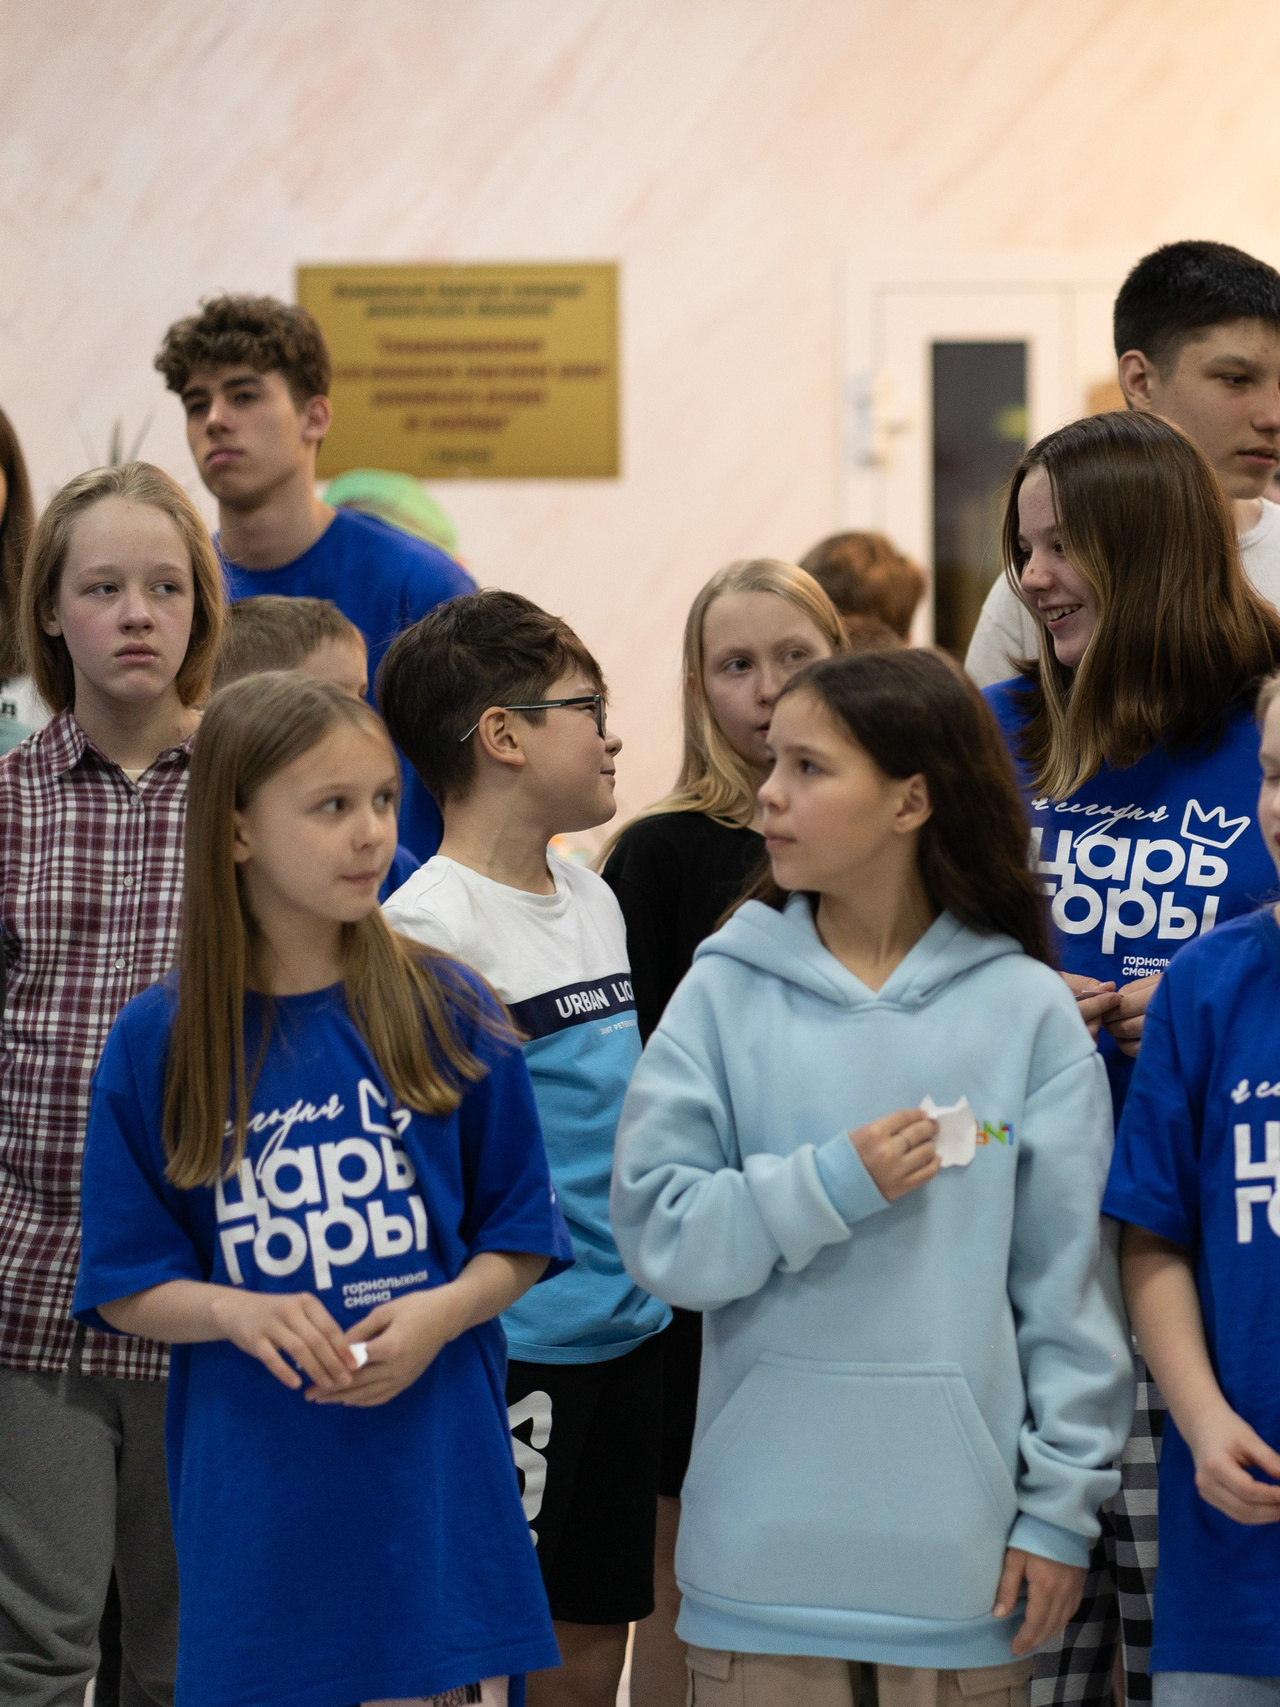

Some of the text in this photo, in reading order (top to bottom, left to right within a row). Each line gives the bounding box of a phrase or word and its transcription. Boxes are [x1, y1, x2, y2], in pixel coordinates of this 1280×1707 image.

[1055, 801, 1170, 848] сегодня
[1028, 827, 1229, 889] царь
[555, 988, 610, 1019] URBAN
[1230, 1078, 1251, 1105] я
[214, 1136, 417, 1226] царь
[219, 1195, 428, 1291] горы
[343, 1290, 392, 1309] смена
